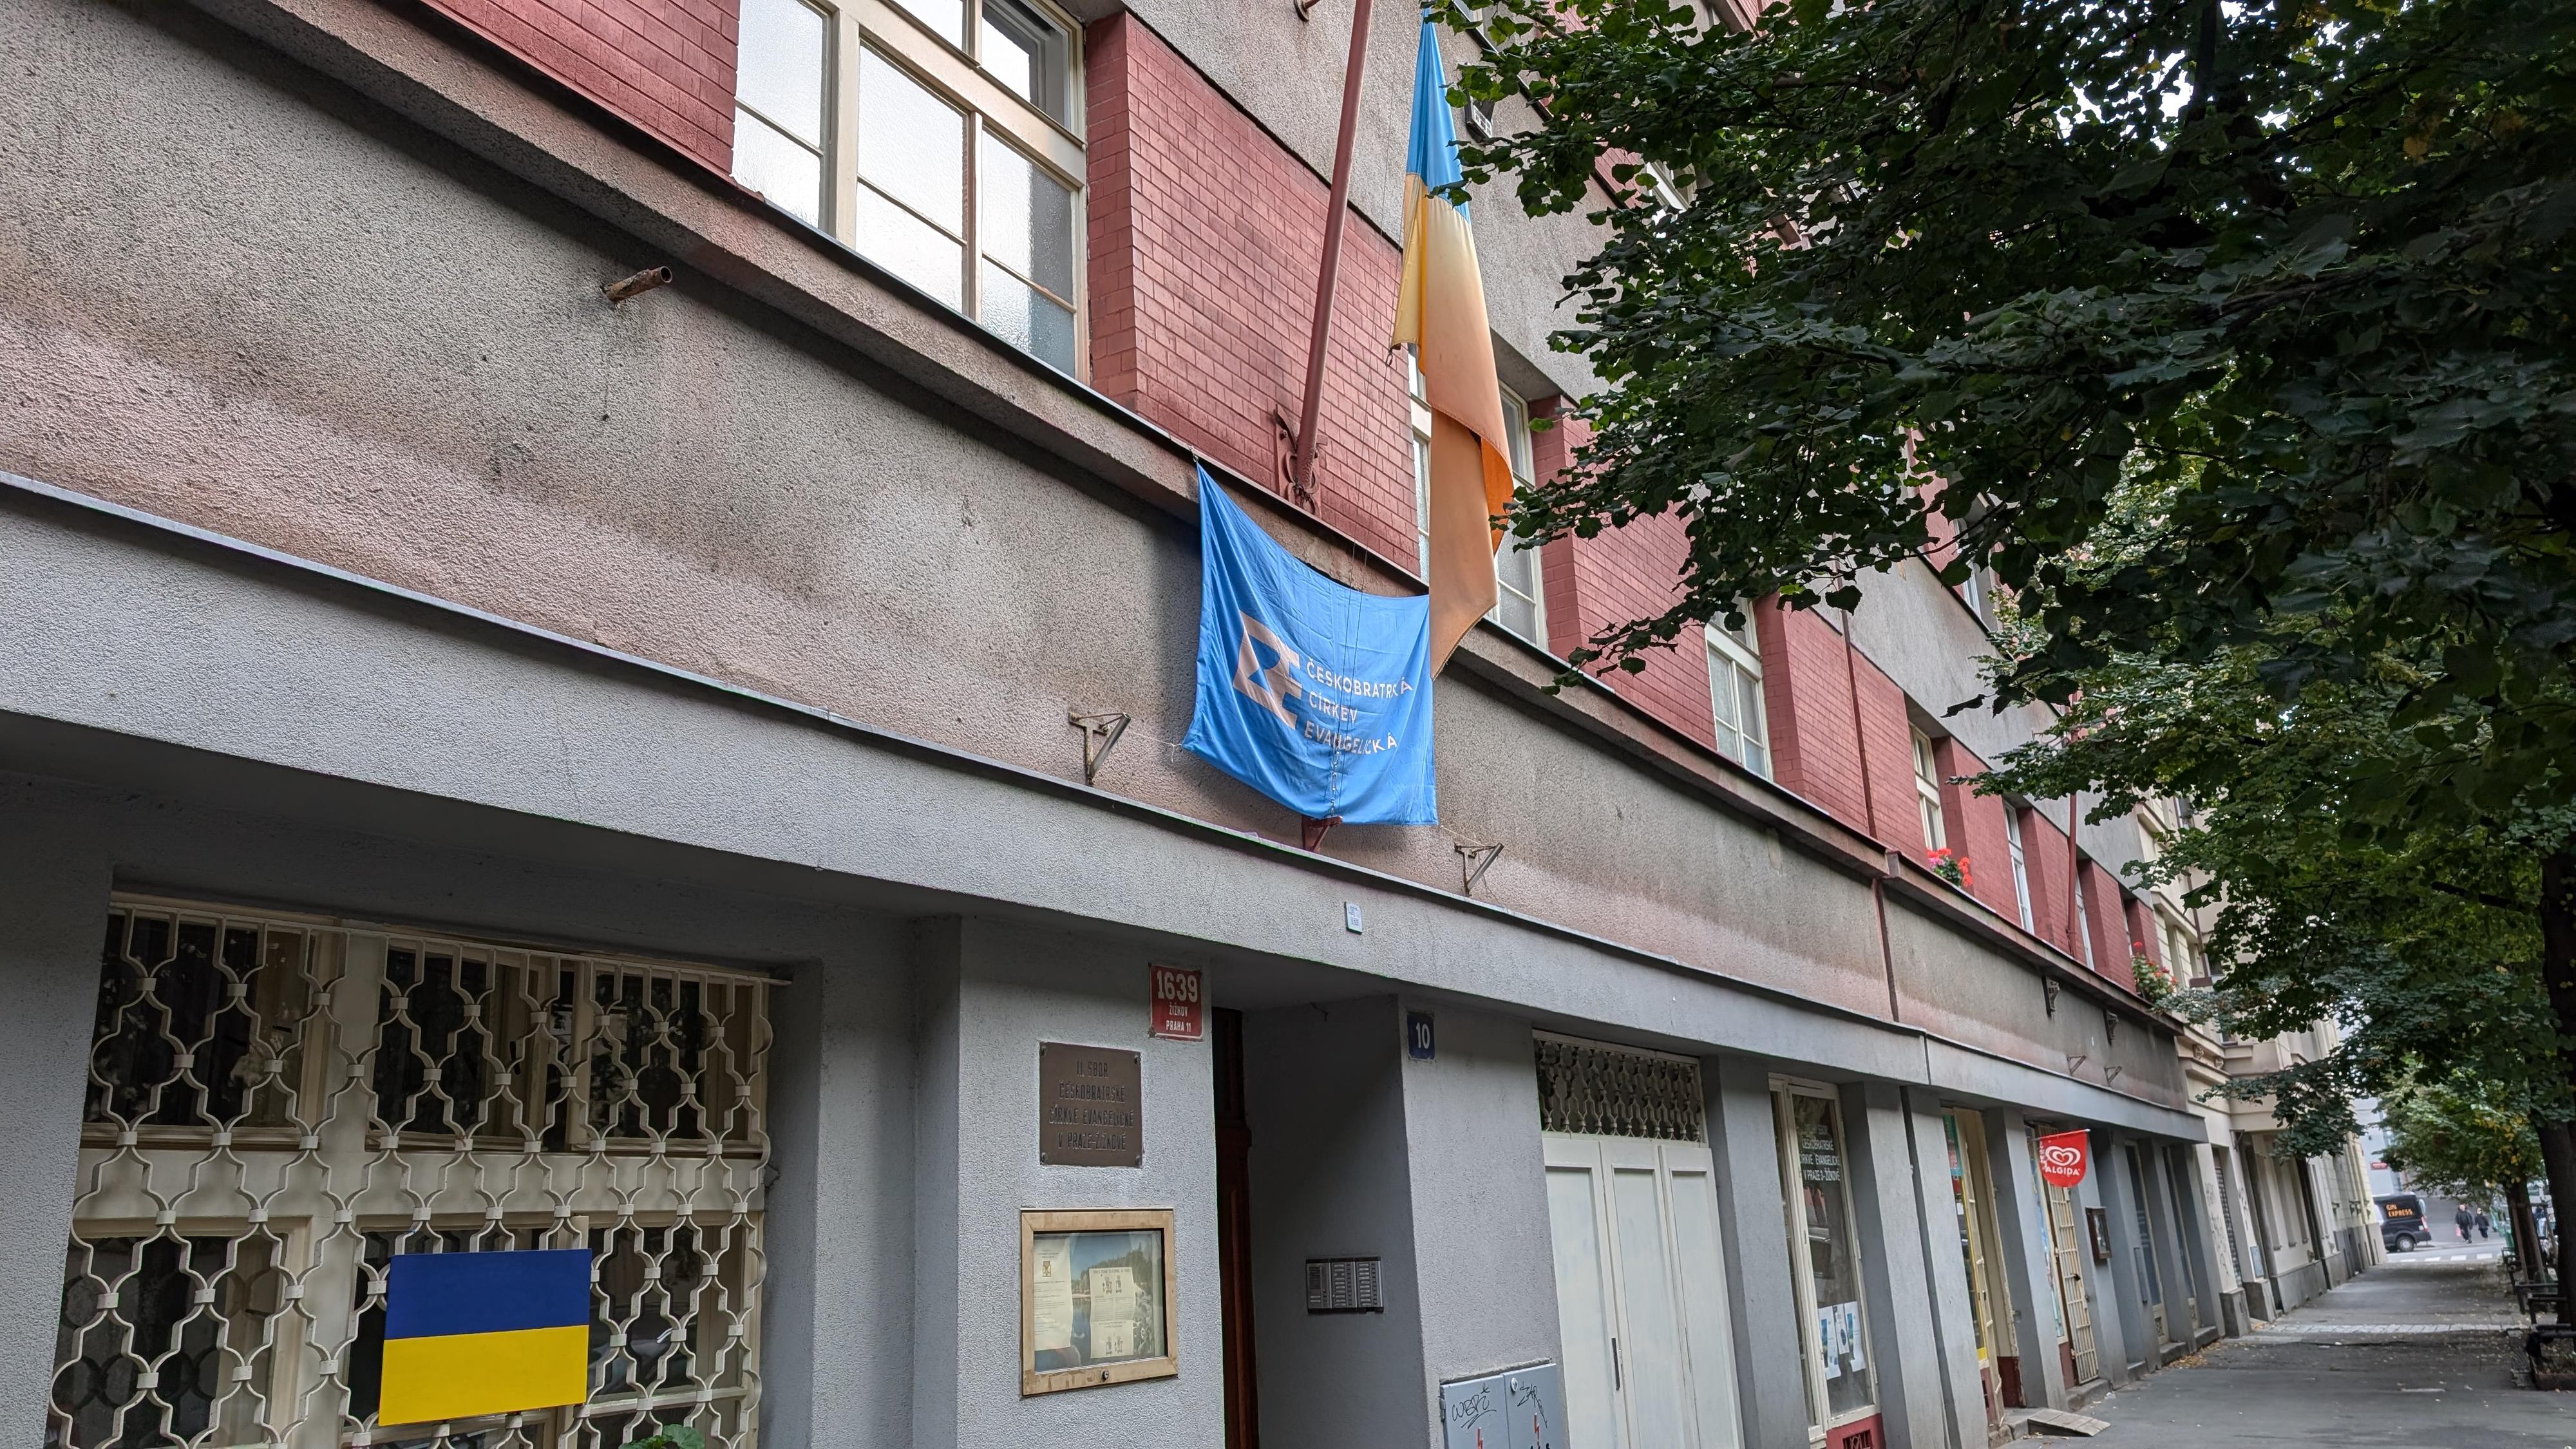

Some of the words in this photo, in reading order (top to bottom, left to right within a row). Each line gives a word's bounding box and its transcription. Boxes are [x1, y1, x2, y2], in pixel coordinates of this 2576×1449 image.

[1307, 656, 1413, 699] ČESKOBRATRKÁ
[1309, 690, 1358, 723] CÍRKEV
[1304, 721, 1397, 755] EVANGELICKÁ
[1157, 971, 1198, 1003] 1639
[1169, 1002, 1188, 1017] ŽIŽKOV
[1166, 1020, 1185, 1032] PRAHA
[1416, 1022, 1430, 1049] 10
[1088, 1061, 1108, 1078] SBOR
[1059, 1079, 1126, 1103] ČESKOBRATRSKÉ
[1048, 1104, 1079, 1125] CÍRKVE
[1083, 1108, 1134, 1128] EVANGELICKÉ
[1058, 1132, 1063, 1150] V
[2045, 1166, 2080, 1177] ALGIDA
[2388, 1208, 2413, 1217] EXPRESS
